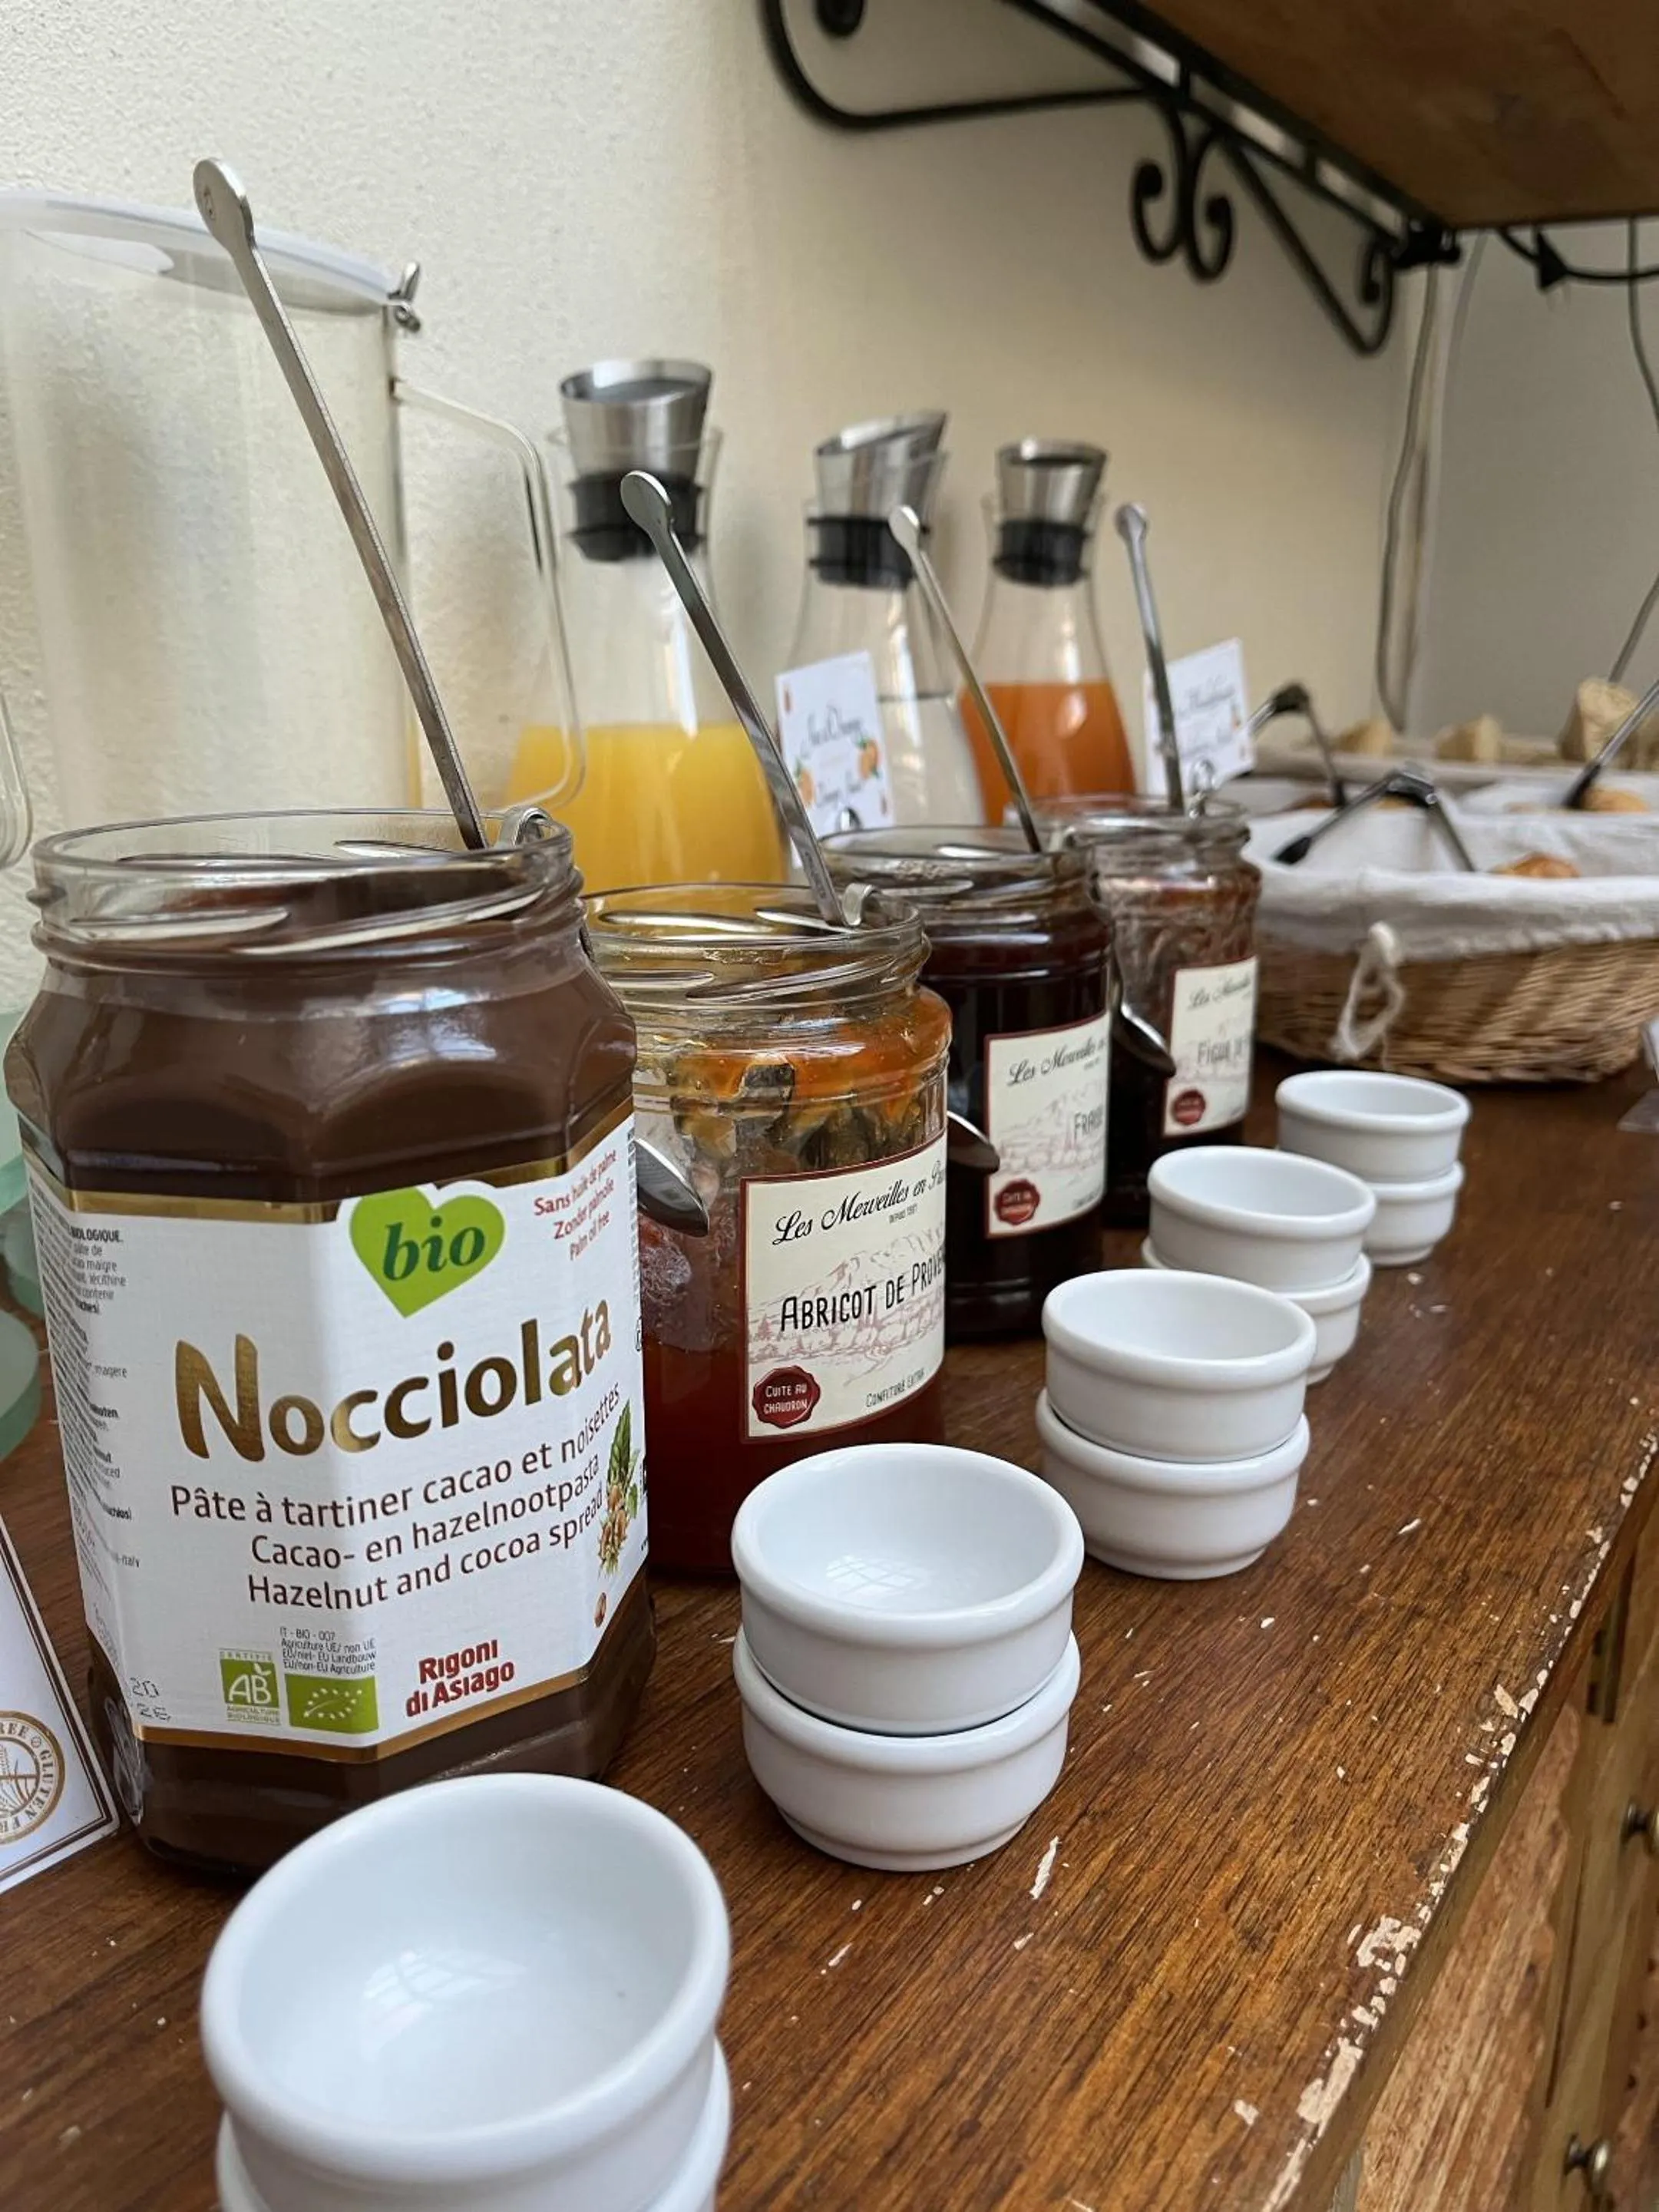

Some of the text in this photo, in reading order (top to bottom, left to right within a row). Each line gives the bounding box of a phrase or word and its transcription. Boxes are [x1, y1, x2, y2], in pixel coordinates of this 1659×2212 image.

[1006, 1060, 1036, 1087] Les
[534, 1194, 570, 1216] Sans
[554, 1206, 587, 1239] Zonder
[772, 1210, 814, 1245] Les
[821, 1179, 910, 1231] Merveilles
[384, 1216, 486, 1281] bio
[780, 1285, 877, 1332] ABRICOT
[885, 1275, 905, 1309] DE
[176, 1299, 611, 1462] Nocciolata
[765, 1383, 806, 1397] CUITE AU
[763, 1400, 808, 1414] CHAUDRON
[170, 1486, 246, 1521] Pâte
[256, 1491, 273, 1523] à
[281, 1486, 413, 1528] tartiner
[423, 1460, 511, 1504] cacao
[522, 1443, 553, 1474] et
[561, 1382, 620, 1463] noisettes
[251, 1535, 355, 1569] Cacao-
[365, 1535, 402, 1562] en
[412, 1453, 600, 1549] hazelnootpasta
[248, 1480, 603, 1610] Hazelnut and cocoa spread
[418, 1639, 497, 1685] Rigoni
[432, 1661, 515, 1708] Asiago
[229, 1673, 272, 1704] AB
